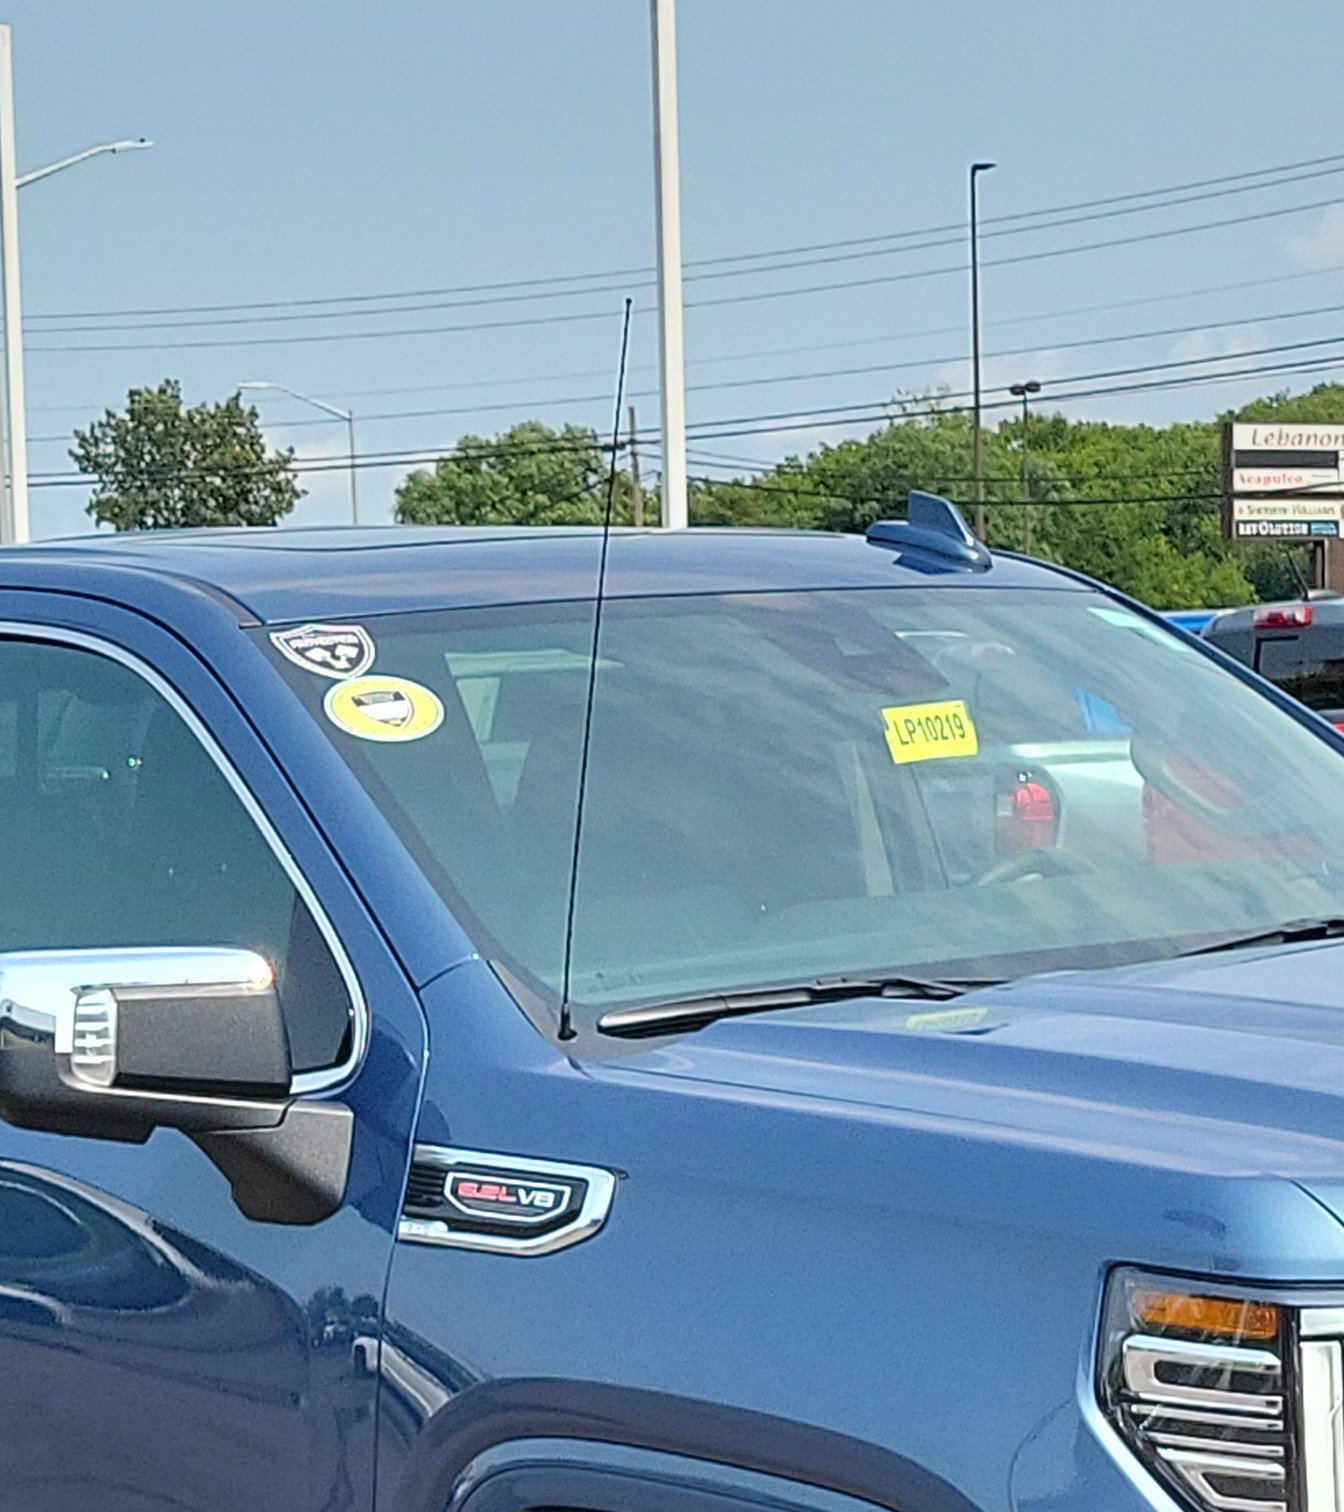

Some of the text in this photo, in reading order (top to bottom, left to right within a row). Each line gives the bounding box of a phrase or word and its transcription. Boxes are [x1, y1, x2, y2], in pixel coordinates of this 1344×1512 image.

[1238, 471, 1304, 487] Acapulco
[893, 712, 966, 746] LP10219
[517, 1187, 556, 1209] V8
